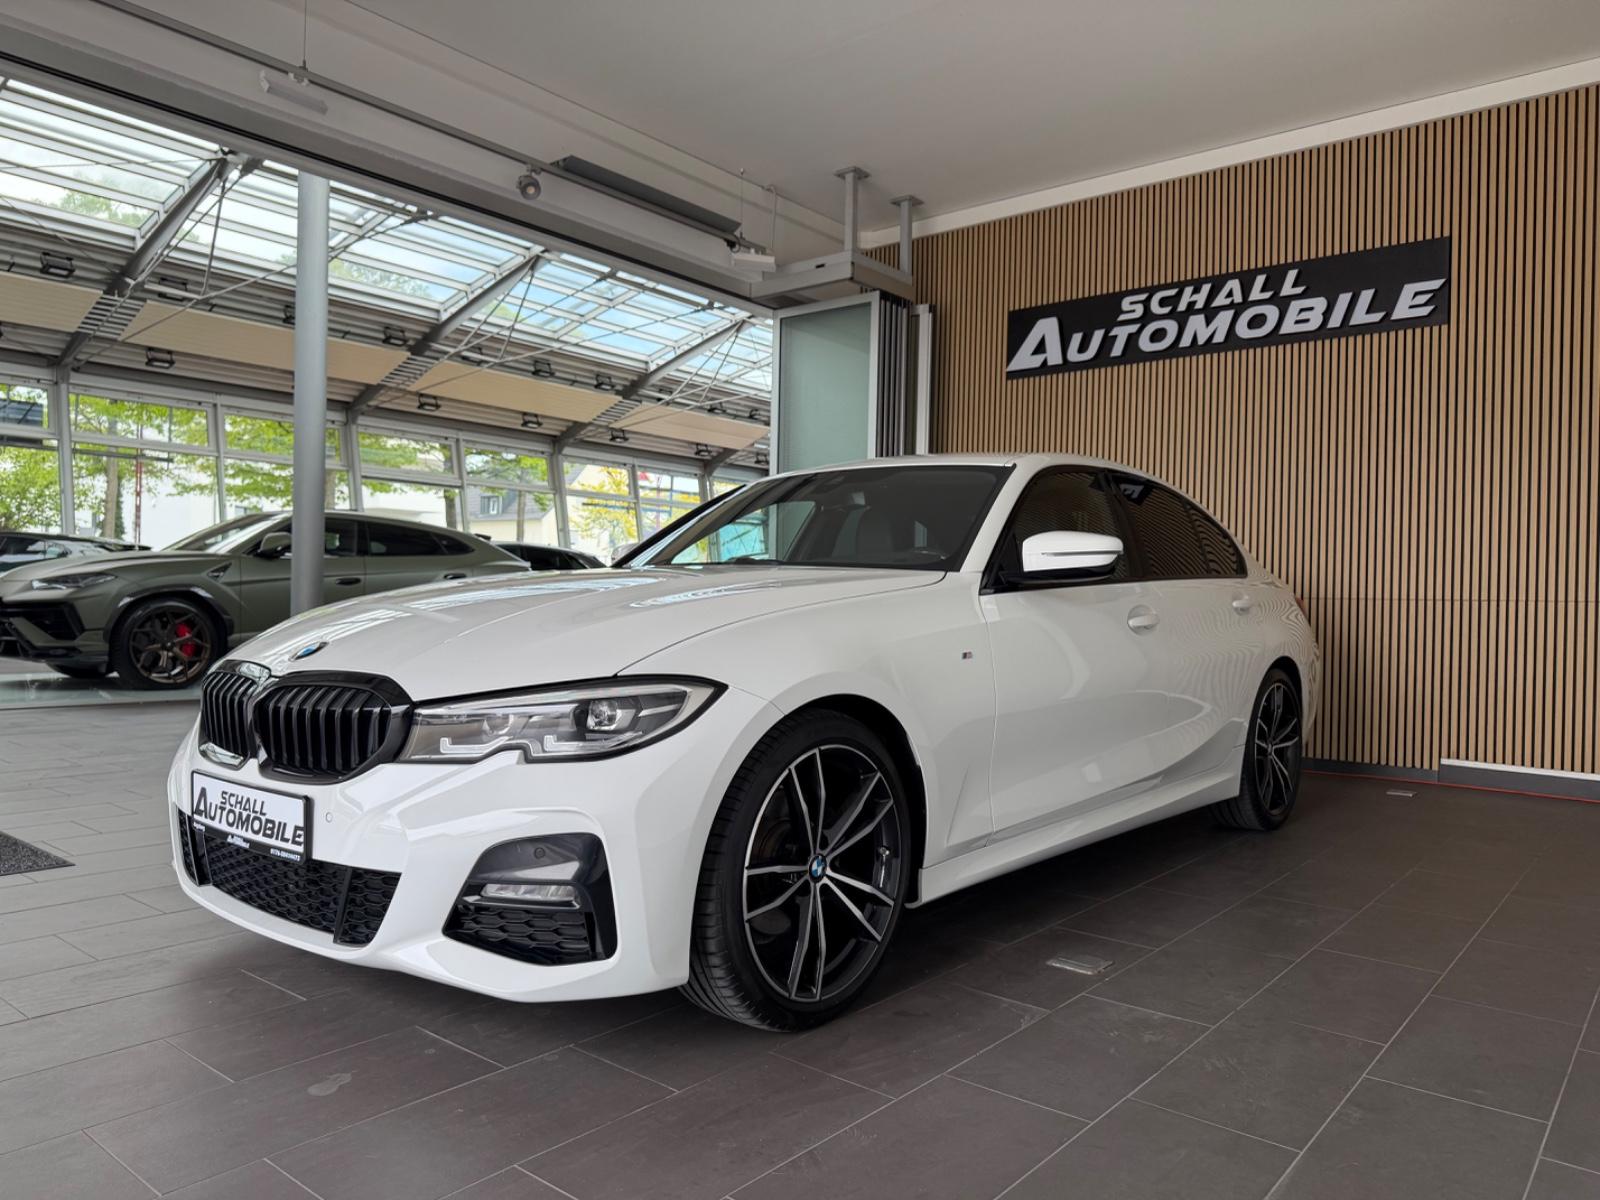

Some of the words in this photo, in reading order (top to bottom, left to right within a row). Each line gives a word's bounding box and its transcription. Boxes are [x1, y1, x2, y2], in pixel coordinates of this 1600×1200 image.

[1116, 268, 1307, 322] SCHALL
[1006, 277, 1448, 373] AUTOMOBILE
[194, 786, 305, 847] AUTOMOBILE
[220, 790, 267, 816] SCHALL
